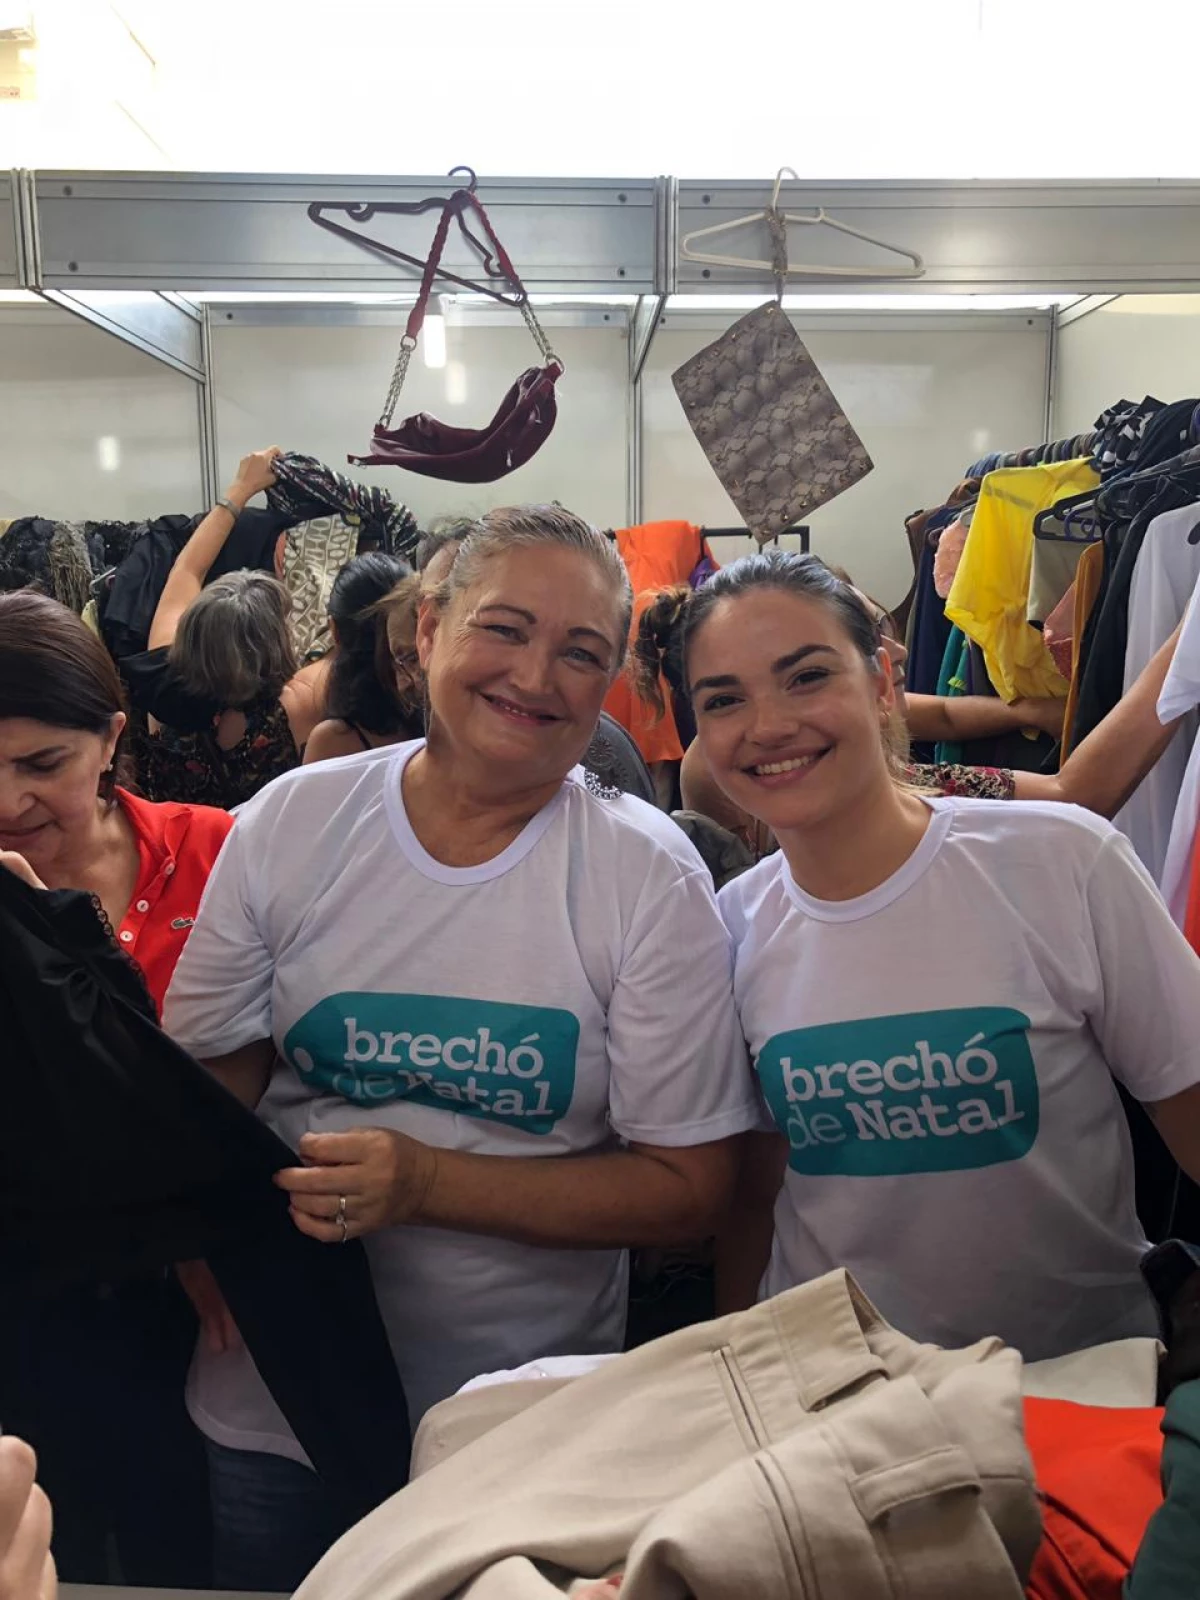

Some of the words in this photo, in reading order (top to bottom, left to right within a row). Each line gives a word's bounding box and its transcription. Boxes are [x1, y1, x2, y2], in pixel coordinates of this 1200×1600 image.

[344, 1018, 544, 1079] brechó
[780, 1032, 998, 1102] brechó
[332, 1063, 397, 1101] de
[786, 1103, 847, 1150] de
[845, 1080, 1025, 1141] Natal
